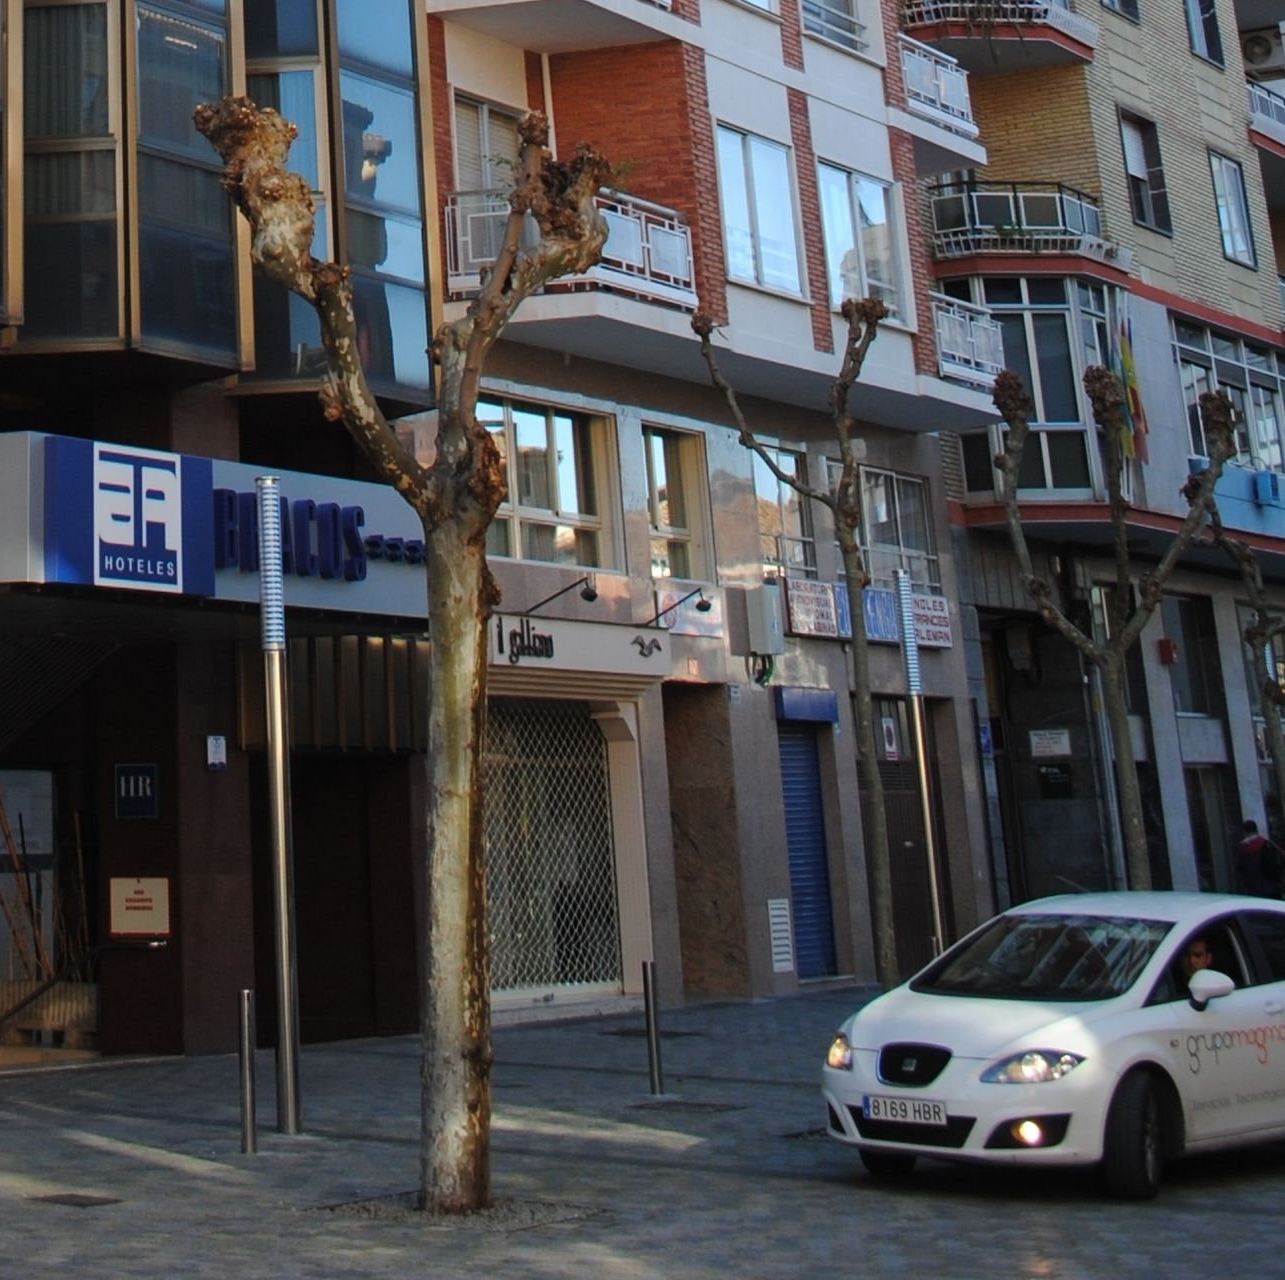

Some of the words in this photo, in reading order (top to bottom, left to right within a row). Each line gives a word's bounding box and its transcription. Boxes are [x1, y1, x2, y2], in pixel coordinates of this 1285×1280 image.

[104, 555, 175, 577] HOTELES
[120, 775, 152, 797] HR
[872, 1098, 908, 1119] 8169
[912, 1103, 942, 1122] HBR
